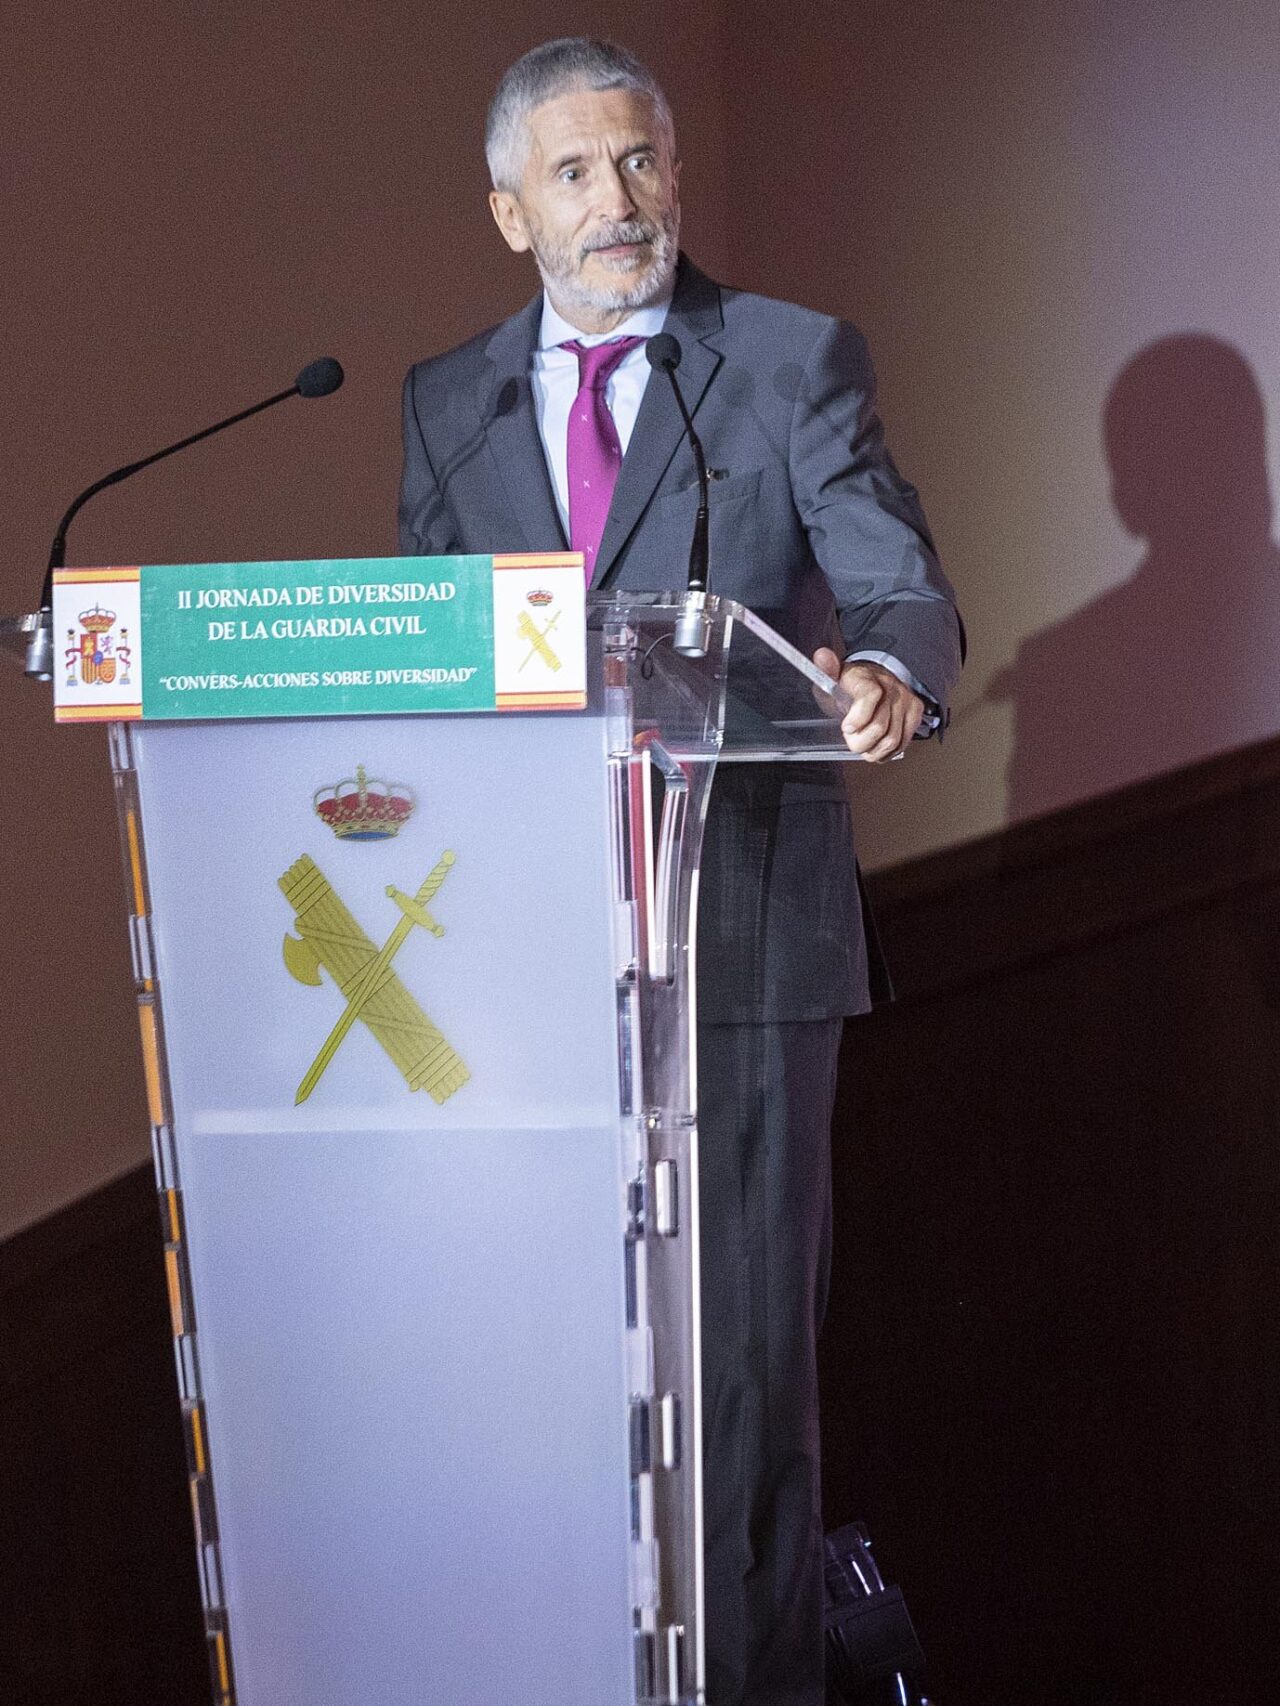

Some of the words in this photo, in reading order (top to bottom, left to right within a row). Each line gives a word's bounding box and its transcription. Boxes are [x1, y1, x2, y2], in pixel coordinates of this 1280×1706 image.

[178, 590, 192, 609] II
[195, 587, 293, 609] JORNADA
[295, 586, 324, 606] DE
[327, 582, 456, 605] DIVERSIDAD
[208, 621, 237, 640] DE
[241, 620, 269, 640] LA
[271, 617, 367, 639] GUARDIA
[369, 615, 427, 636] CIVIL
[322, 670, 373, 686] SOBRE
